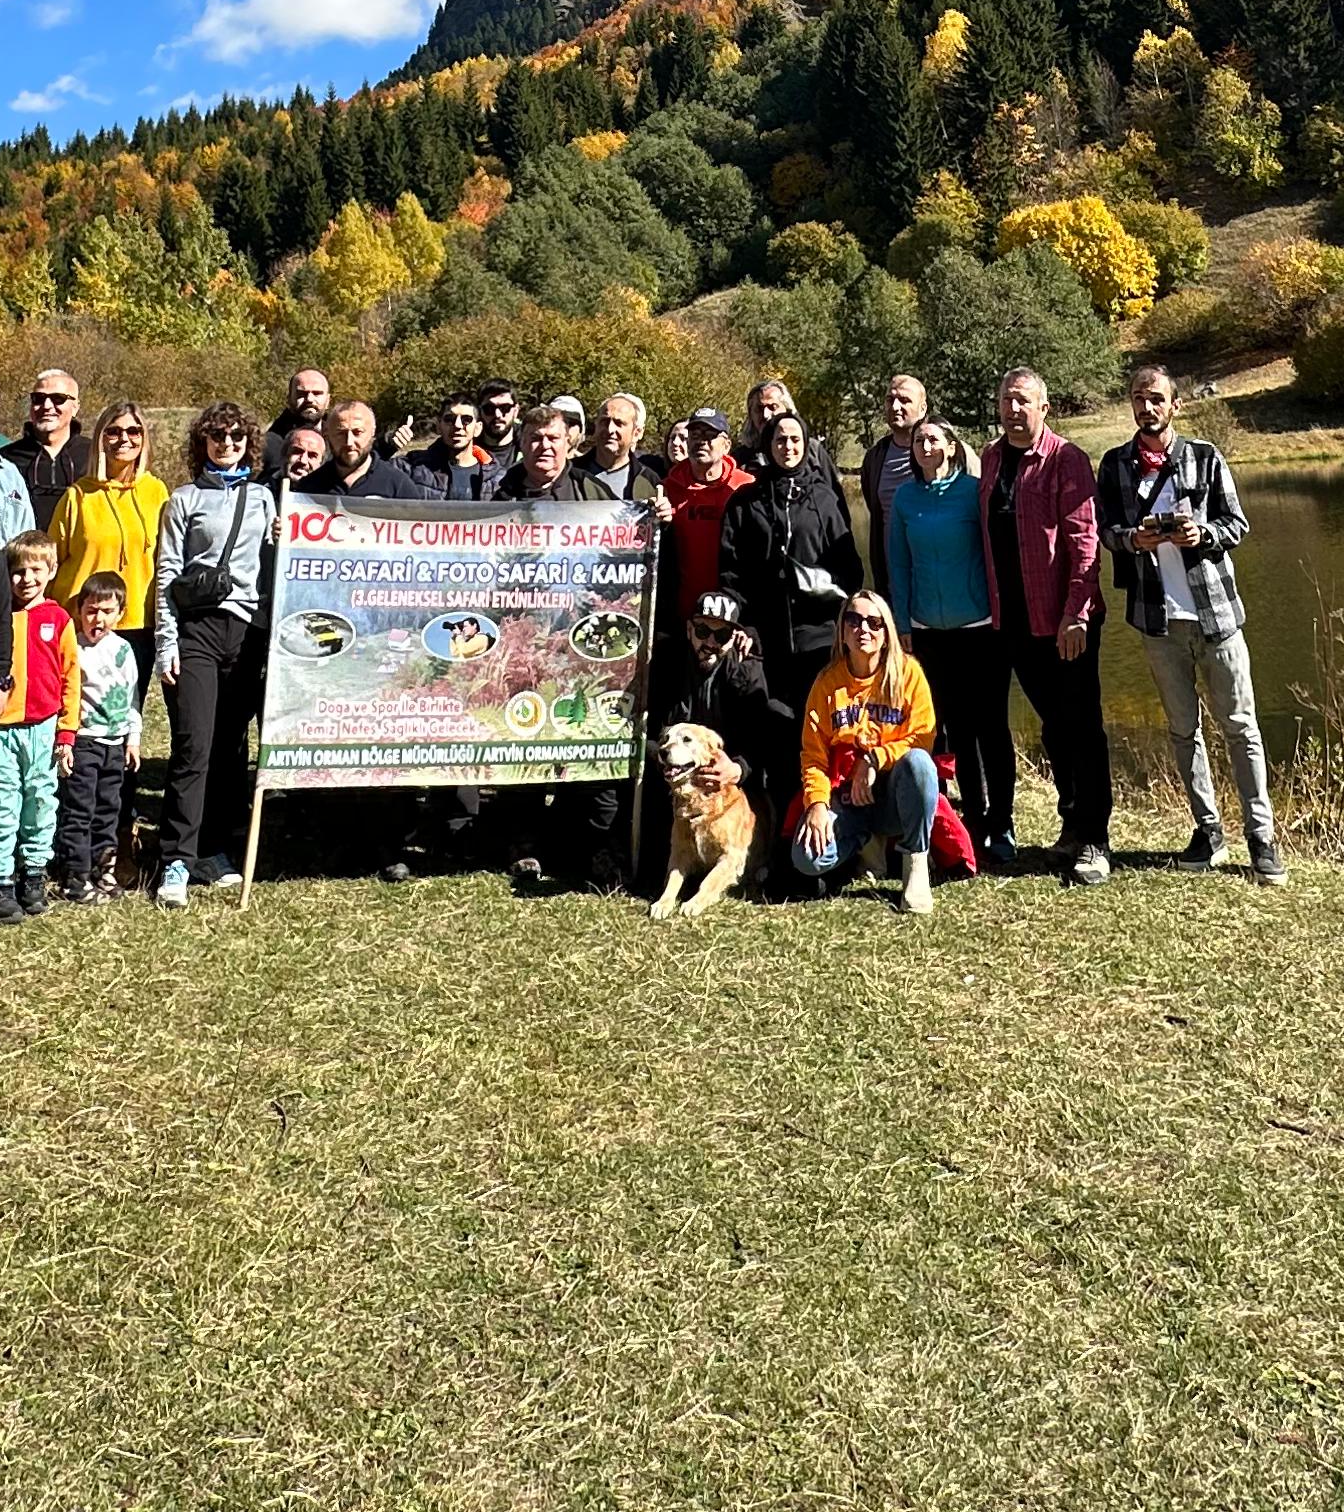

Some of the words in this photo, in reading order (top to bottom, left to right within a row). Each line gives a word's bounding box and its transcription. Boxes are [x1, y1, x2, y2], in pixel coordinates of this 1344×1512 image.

[372, 521, 404, 545] YIL
[410, 518, 555, 547] CUMHURİYET
[285, 557, 337, 582] JEEP
[339, 555, 414, 583] SAFARİ
[416, 561, 434, 583] &
[436, 561, 494, 584] FOTO
[497, 557, 569, 585] SAFARİ
[572, 562, 589, 585] &
[591, 563, 648, 585] KAMP
[446, 587, 491, 609] SAFARİ
[491, 587, 575, 612] ETKİNLİKLERİ)
[702, 595, 737, 621] NY
[354, 703, 368, 713] ve
[371, 700, 399, 717] Spor
[419, 698, 461, 713] Birlikte
[300, 721, 336, 735] Temiz
[341, 721, 376, 735] Nefes
[429, 719, 476, 734] Gelecek
[267, 747, 312, 767] ARTVİN
[313, 748, 361, 767] ORMAN
[361, 745, 401, 766] BÖLGE
[401, 744, 475, 765] MÜDÜRLÜĞÜ
[475, 746, 482, 763] /
[483, 743, 525, 763] ARTVİN
[525, 744, 596, 762] ORMANSPOR
[596, 740, 638, 759] KULÜBÜ
